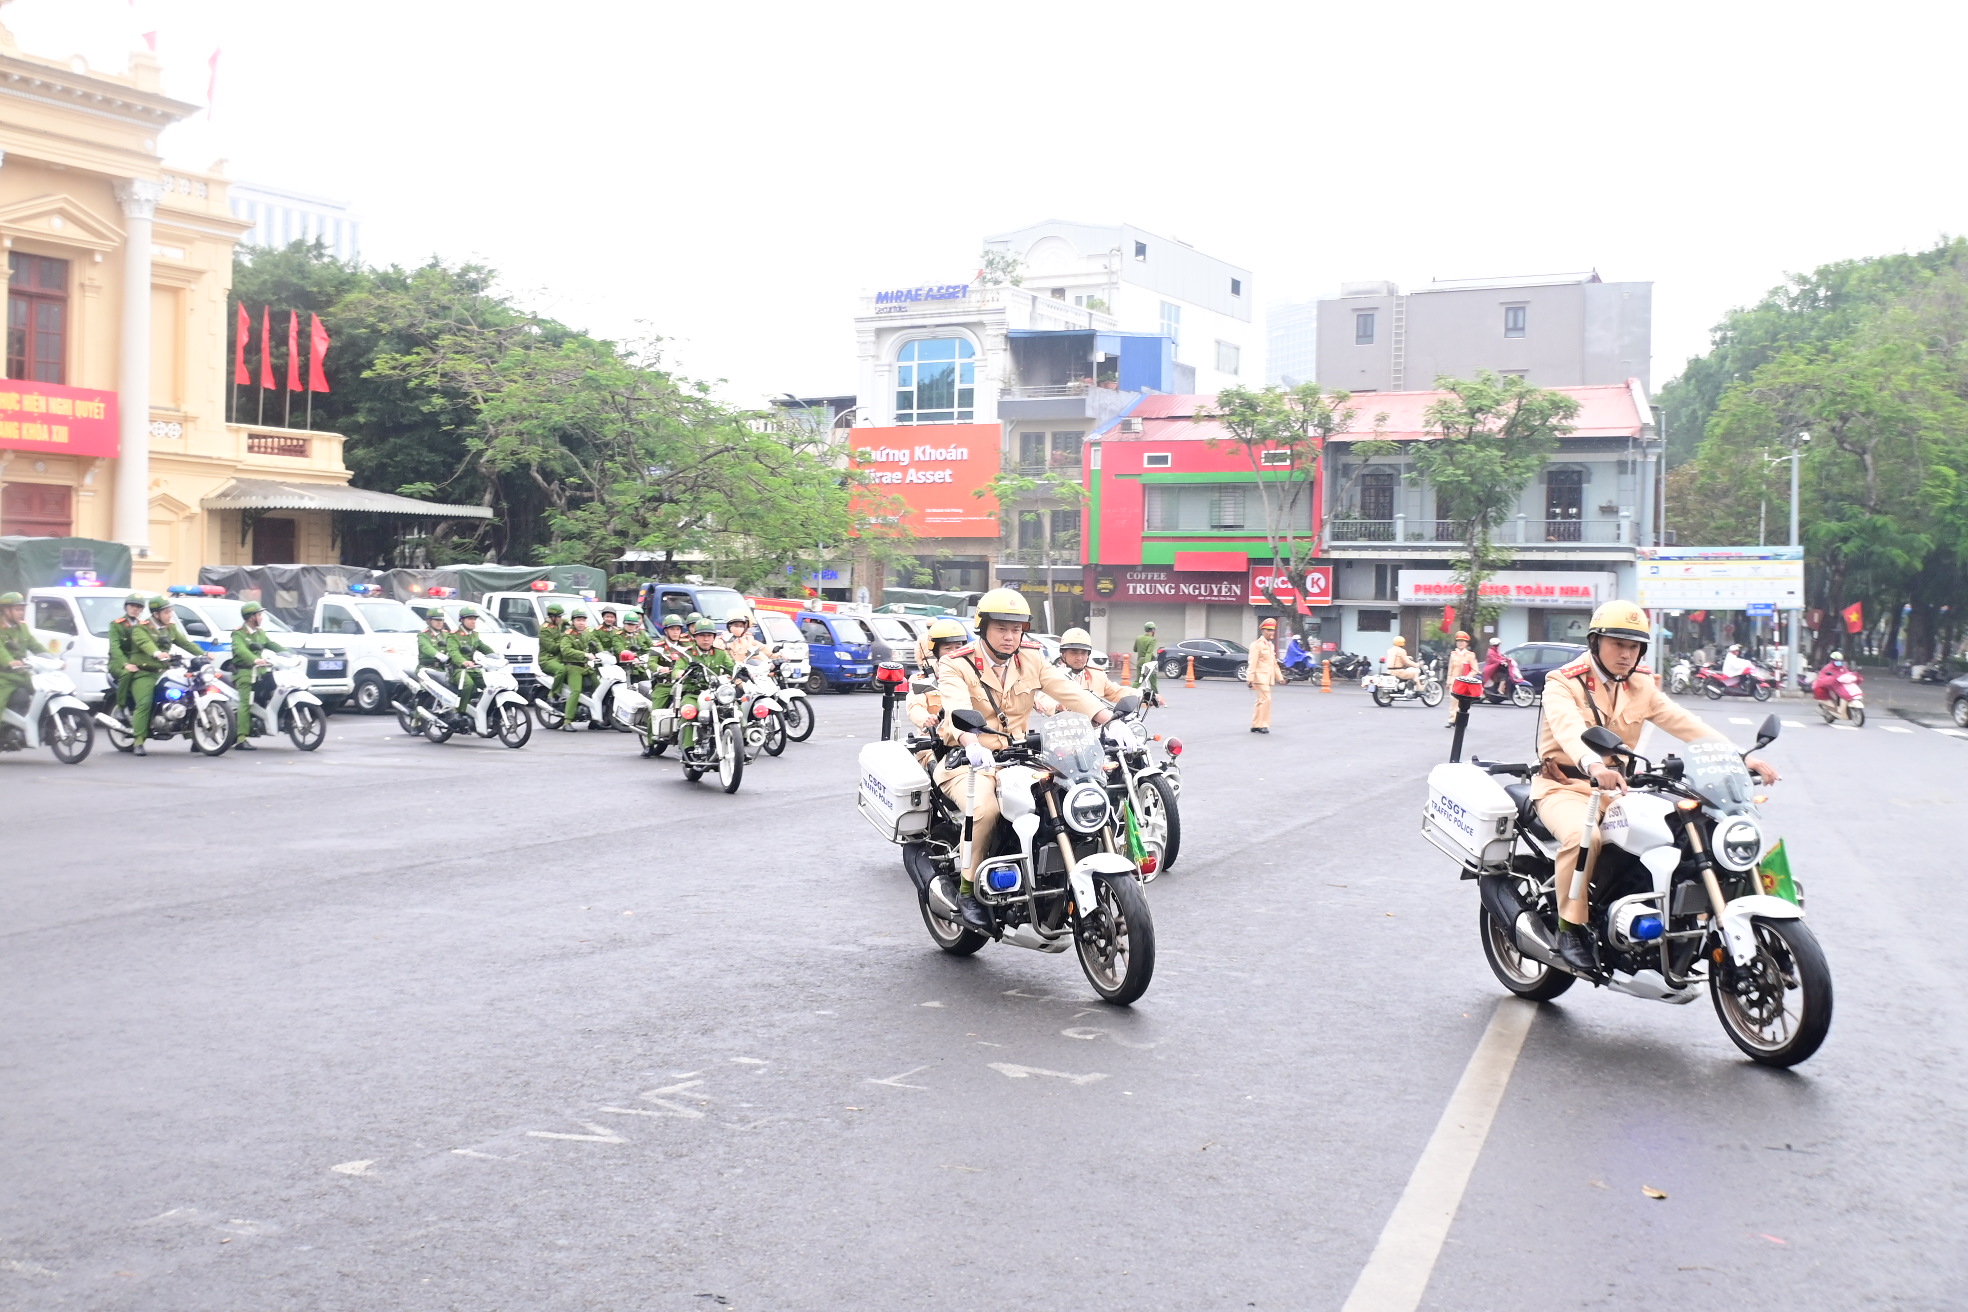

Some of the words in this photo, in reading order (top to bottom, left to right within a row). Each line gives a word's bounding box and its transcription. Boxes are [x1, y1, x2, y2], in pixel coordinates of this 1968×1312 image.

[875, 288, 922, 304] MIRAE
[924, 284, 969, 300] ASSET
[914, 444, 968, 461] Khoán
[905, 468, 953, 484] Asset
[1127, 572, 1167, 580] COFFEE
[1127, 583, 1175, 595] TRUNG
[1179, 581, 1241, 596] NGUYÊN
[1414, 582, 1466, 595] PHÒNG
[1558, 585, 1592, 597] NHA
[1044, 718, 1089, 729] CSGT
[1692, 754, 1742, 764] TRAFFIC
[1696, 765, 1745, 777] POLICE
[868, 774, 886, 793] CSGT
[863, 778, 878, 797] TRAFFIC
[878, 793, 893, 810] POLICE
[1441, 796, 1466, 818] CSGT
[1431, 800, 1453, 822] TRAFFIC
[1453, 817, 1474, 837] POLICE
